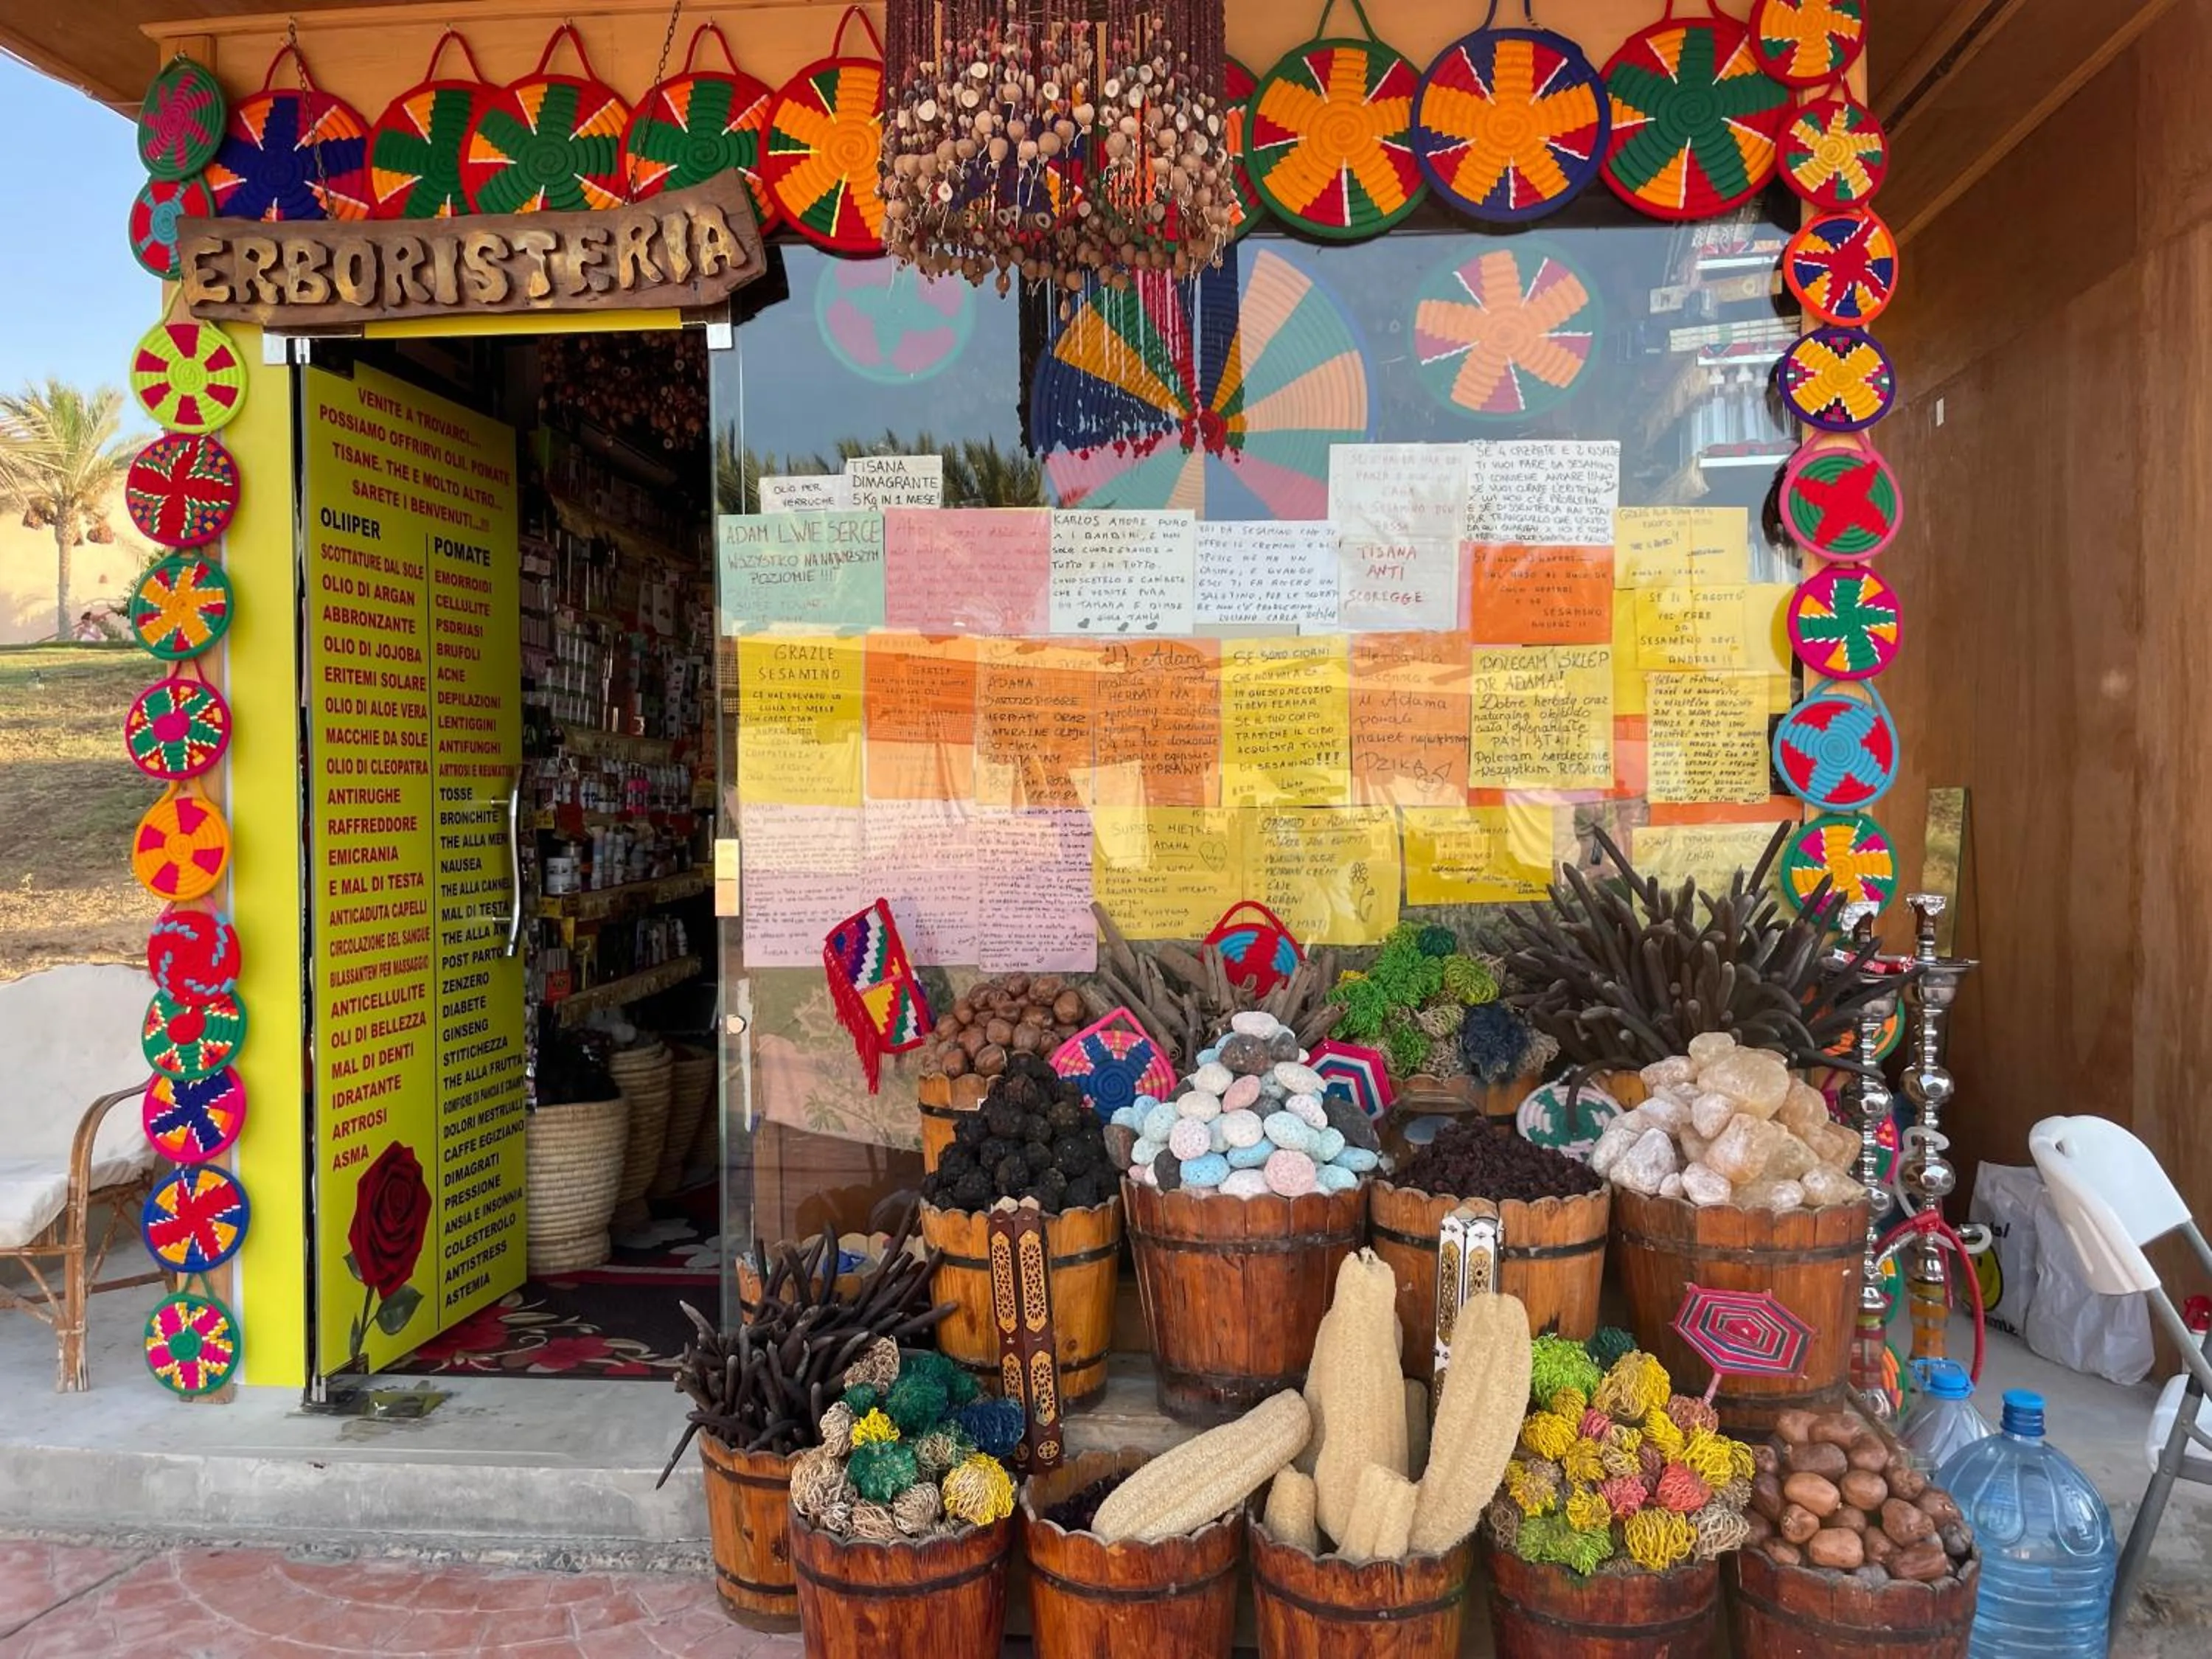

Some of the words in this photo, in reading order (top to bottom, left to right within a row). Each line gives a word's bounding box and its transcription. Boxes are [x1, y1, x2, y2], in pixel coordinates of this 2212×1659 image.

[184, 204, 747, 306] ERBORISTERIA
[358, 387, 401, 417] VENITE
[406, 411, 413, 422] A
[319, 404, 386, 441] POSSIAMO
[389, 431, 442, 462] OFFRIRVI
[471, 460, 510, 487] POMATE
[386, 459, 408, 480] THE
[412, 470, 419, 484] E
[423, 473, 459, 496] MOLTO
[851, 460, 906, 473] TISANA
[801, 484, 821, 492] PER
[853, 475, 938, 489] DIMAGRANTE
[352, 480, 399, 508] SARETE
[783, 497, 834, 507] VERRUCHE
[881, 495, 891, 504] IN
[896, 495, 902, 504] 1
[727, 524, 769, 544] ADAM
[320, 543, 381, 571] SCOTTATURE
[384, 558, 400, 576] DAL
[403, 562, 424, 580] SOLE
[434, 537, 490, 566] POMATE
[1357, 545, 1416, 560] TISANA
[435, 570, 492, 594] EMORROIDI
[1366, 564, 1404, 580] ANTI
[322, 574, 353, 594] OLIO
[358, 581, 369, 598] DI
[374, 585, 415, 606] ARGAN
[435, 594, 490, 616] CELLULITE
[322, 605, 416, 634] ABBRONZANTE
[324, 636, 355, 654] OLIO
[359, 641, 371, 656] DI
[376, 644, 422, 664] JOJOBA
[436, 643, 481, 661] BRUFOLI
[1480, 653, 1547, 671] POLECAM
[1558, 651, 1610, 669] SKLEP
[324, 667, 377, 686] ERITEMI
[381, 672, 426, 692] SOLARE
[437, 667, 466, 682] ACNE
[758, 667, 840, 681] SESAMINO
[325, 698, 352, 714] OLIO
[357, 700, 366, 715] DI
[371, 702, 398, 717] ALOE
[400, 703, 428, 720] VERA
[438, 692, 501, 709] DEPILAZIONI
[439, 716, 496, 731] LENTIGGINI
[326, 728, 380, 745] MACCHIE
[383, 731, 397, 746] DA
[400, 732, 428, 748] SOLE
[439, 740, 501, 754] ANTIFUNGHI
[327, 758, 352, 774] OLIO
[357, 759, 367, 774] DI
[371, 759, 428, 776] CLEOPATRA
[327, 789, 400, 804] ANTIRUGHE
[440, 787, 473, 801] TOSSE
[328, 816, 417, 835] RAFFREDDORE
[440, 810, 499, 825] BRONCHITE
[440, 835, 460, 849] THE
[462, 835, 486, 848] ALLA
[329, 846, 399, 866] EMICRANIA
[441, 858, 482, 873] NAUSEA
[330, 880, 337, 896] E
[341, 876, 367, 894] MAL
[372, 875, 383, 891] DI
[388, 872, 424, 888] TESTA
[441, 885, 457, 897] THE
[459, 882, 480, 894] ALLA
[330, 904, 389, 928] ANTICADUTA
[392, 900, 427, 919] CAPELLI
[442, 908, 463, 921] MAL
[466, 904, 476, 918] DI
[479, 901, 509, 917] TESTA
[330, 932, 386, 957] CIRCOLAZIONE
[388, 930, 400, 946] DEL
[403, 926, 430, 945] SANGUE
[442, 932, 462, 946] THE
[466, 928, 490, 941] ALLA
[442, 955, 467, 970] POST
[472, 948, 503, 963] PARTO
[442, 971, 489, 994] ZENZERO
[331, 984, 425, 1019] ANTICELLULITE
[442, 995, 487, 1018] DIABETE
[331, 1032, 351, 1048] OLI
[355, 1027, 366, 1042] DI
[371, 1012, 426, 1039] BELLEZZA
[443, 1018, 489, 1042] GINSENG
[332, 1062, 358, 1079] MAL
[363, 1054, 375, 1070] DI
[379, 1041, 414, 1065] DENTI
[443, 1036, 508, 1067] STITICHEZZA
[444, 1074, 462, 1091] THE
[466, 1065, 489, 1084] ALLA
[490, 1054, 523, 1076] FRUTTA
[332, 1074, 402, 1110] IDRATANTE
[332, 1108, 387, 1141] ARTROSI
[444, 1118, 476, 1139] DOLORI
[478, 1099, 523, 1125] MESTRUALI
[444, 1138, 477, 1163] CAFFE
[480, 1119, 524, 1144] EGIZIANO
[333, 1144, 369, 1172] ASMA
[445, 1152, 500, 1187] DIMAGRATI
[445, 1174, 501, 1211] PRESSIONE
[445, 1210, 473, 1235] ANSIA
[481, 1187, 524, 1217] INSONNIA
[445, 1213, 515, 1259] COLESTEROLO
[445, 1240, 507, 1284] ANTISTRESS
[445, 1272, 490, 1308] ASTEMIA
